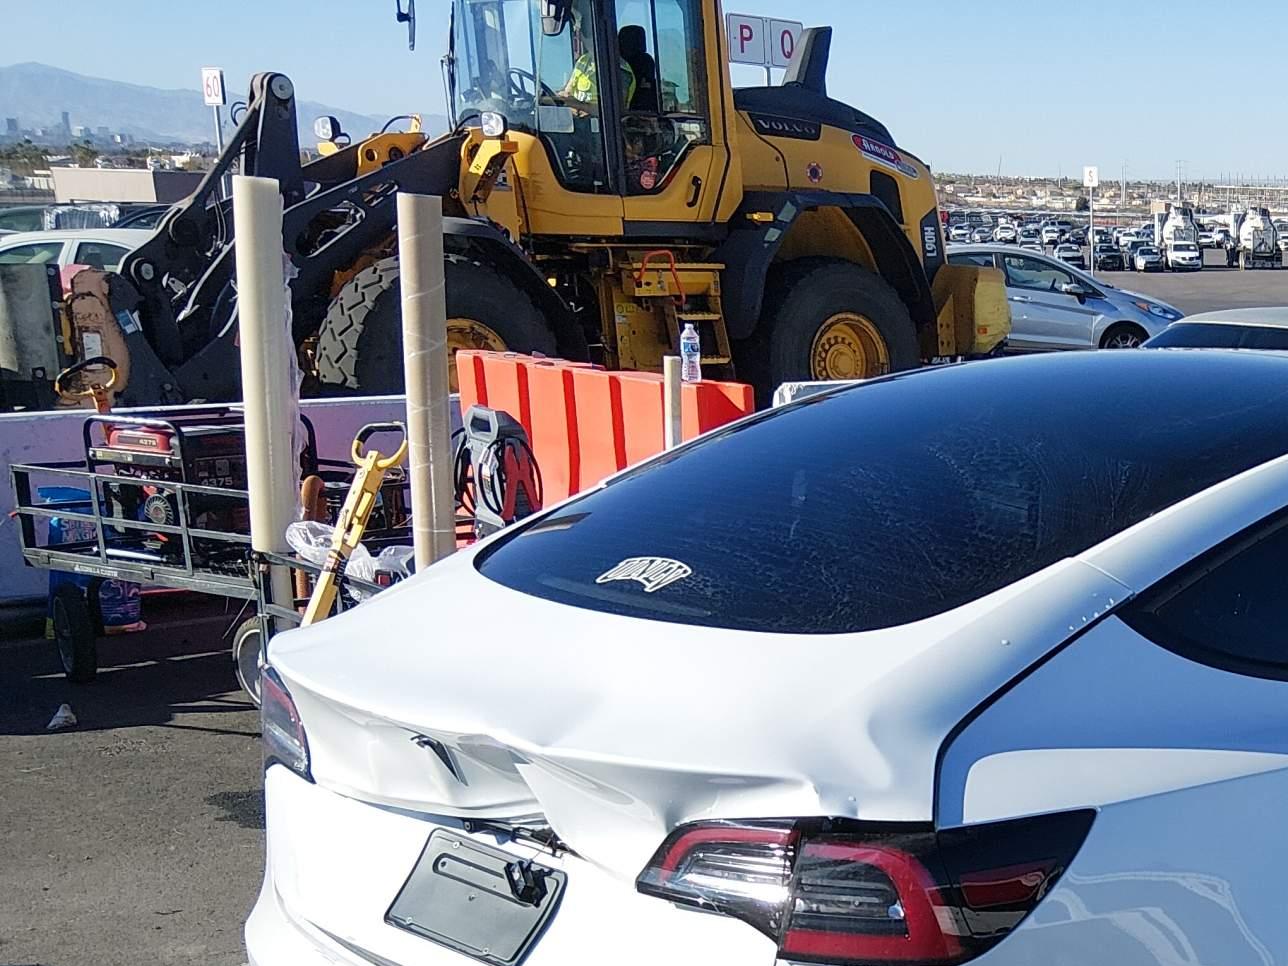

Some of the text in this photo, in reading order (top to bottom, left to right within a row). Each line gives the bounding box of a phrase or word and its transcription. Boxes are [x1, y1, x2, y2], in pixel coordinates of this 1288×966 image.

[740, 24, 794, 59] P Q
[206, 75, 220, 97] 60
[758, 119, 816, 134] VOLVO
[924, 226, 937, 257] L90H
[201, 476, 233, 487] 4375
